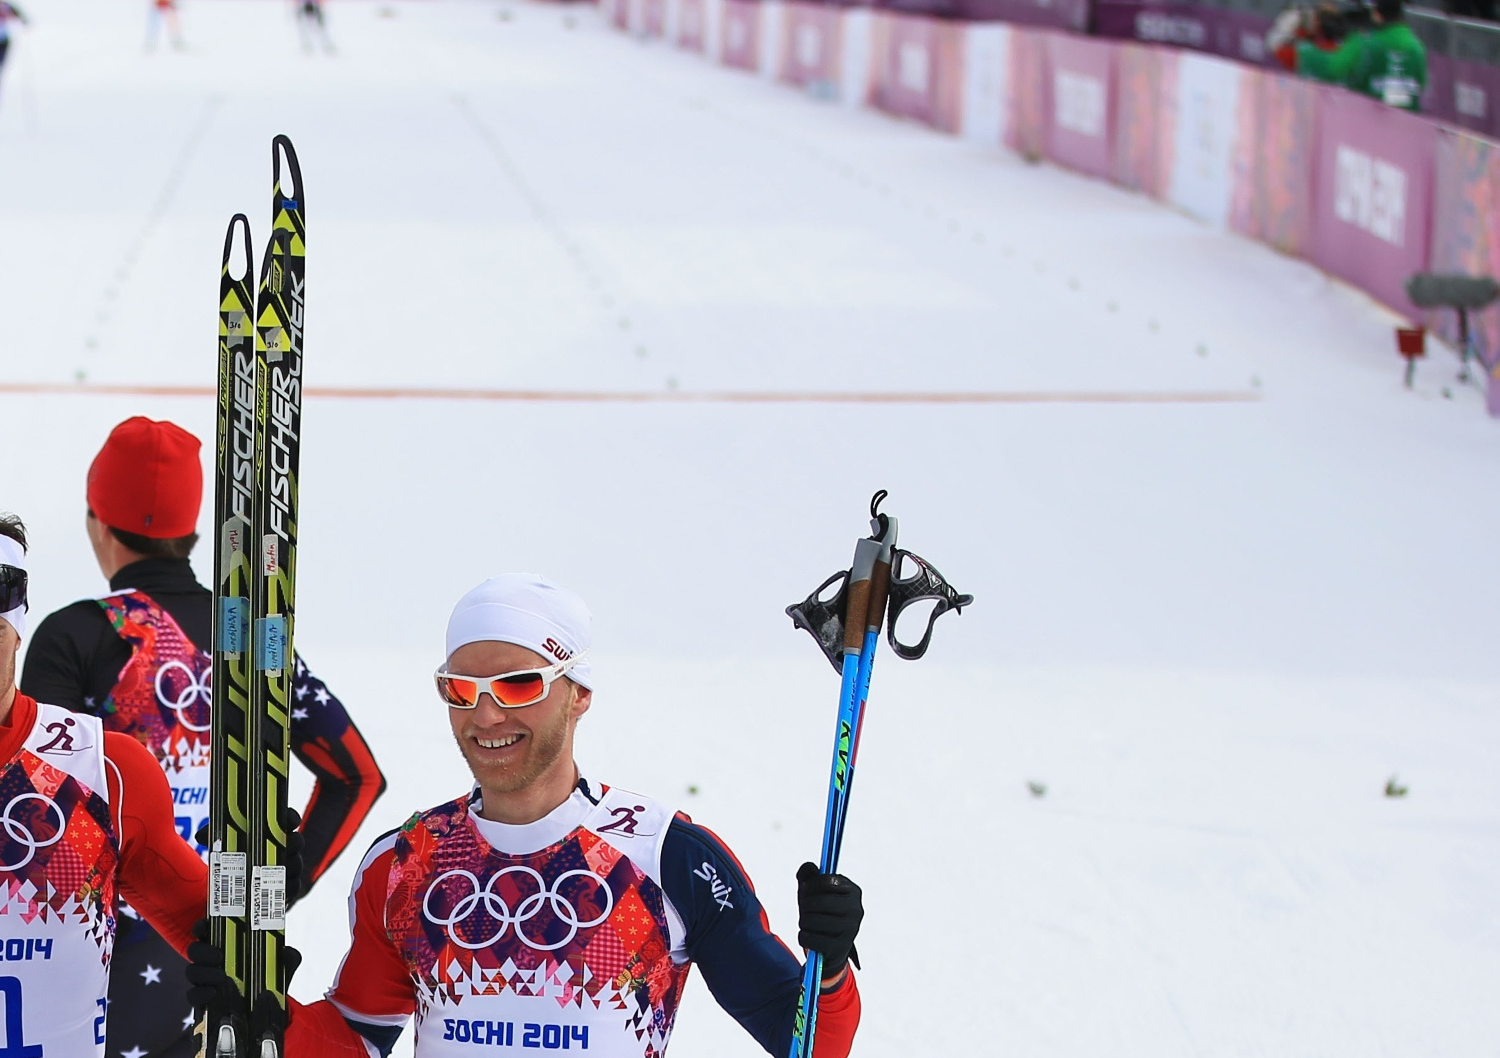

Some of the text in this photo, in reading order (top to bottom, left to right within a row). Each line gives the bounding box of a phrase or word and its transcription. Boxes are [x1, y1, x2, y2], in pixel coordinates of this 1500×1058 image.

[231, 351, 256, 527] FISCHER
[270, 366, 290, 541] FISCHER
[443, 1018, 589, 1050] SOCHI 2014
